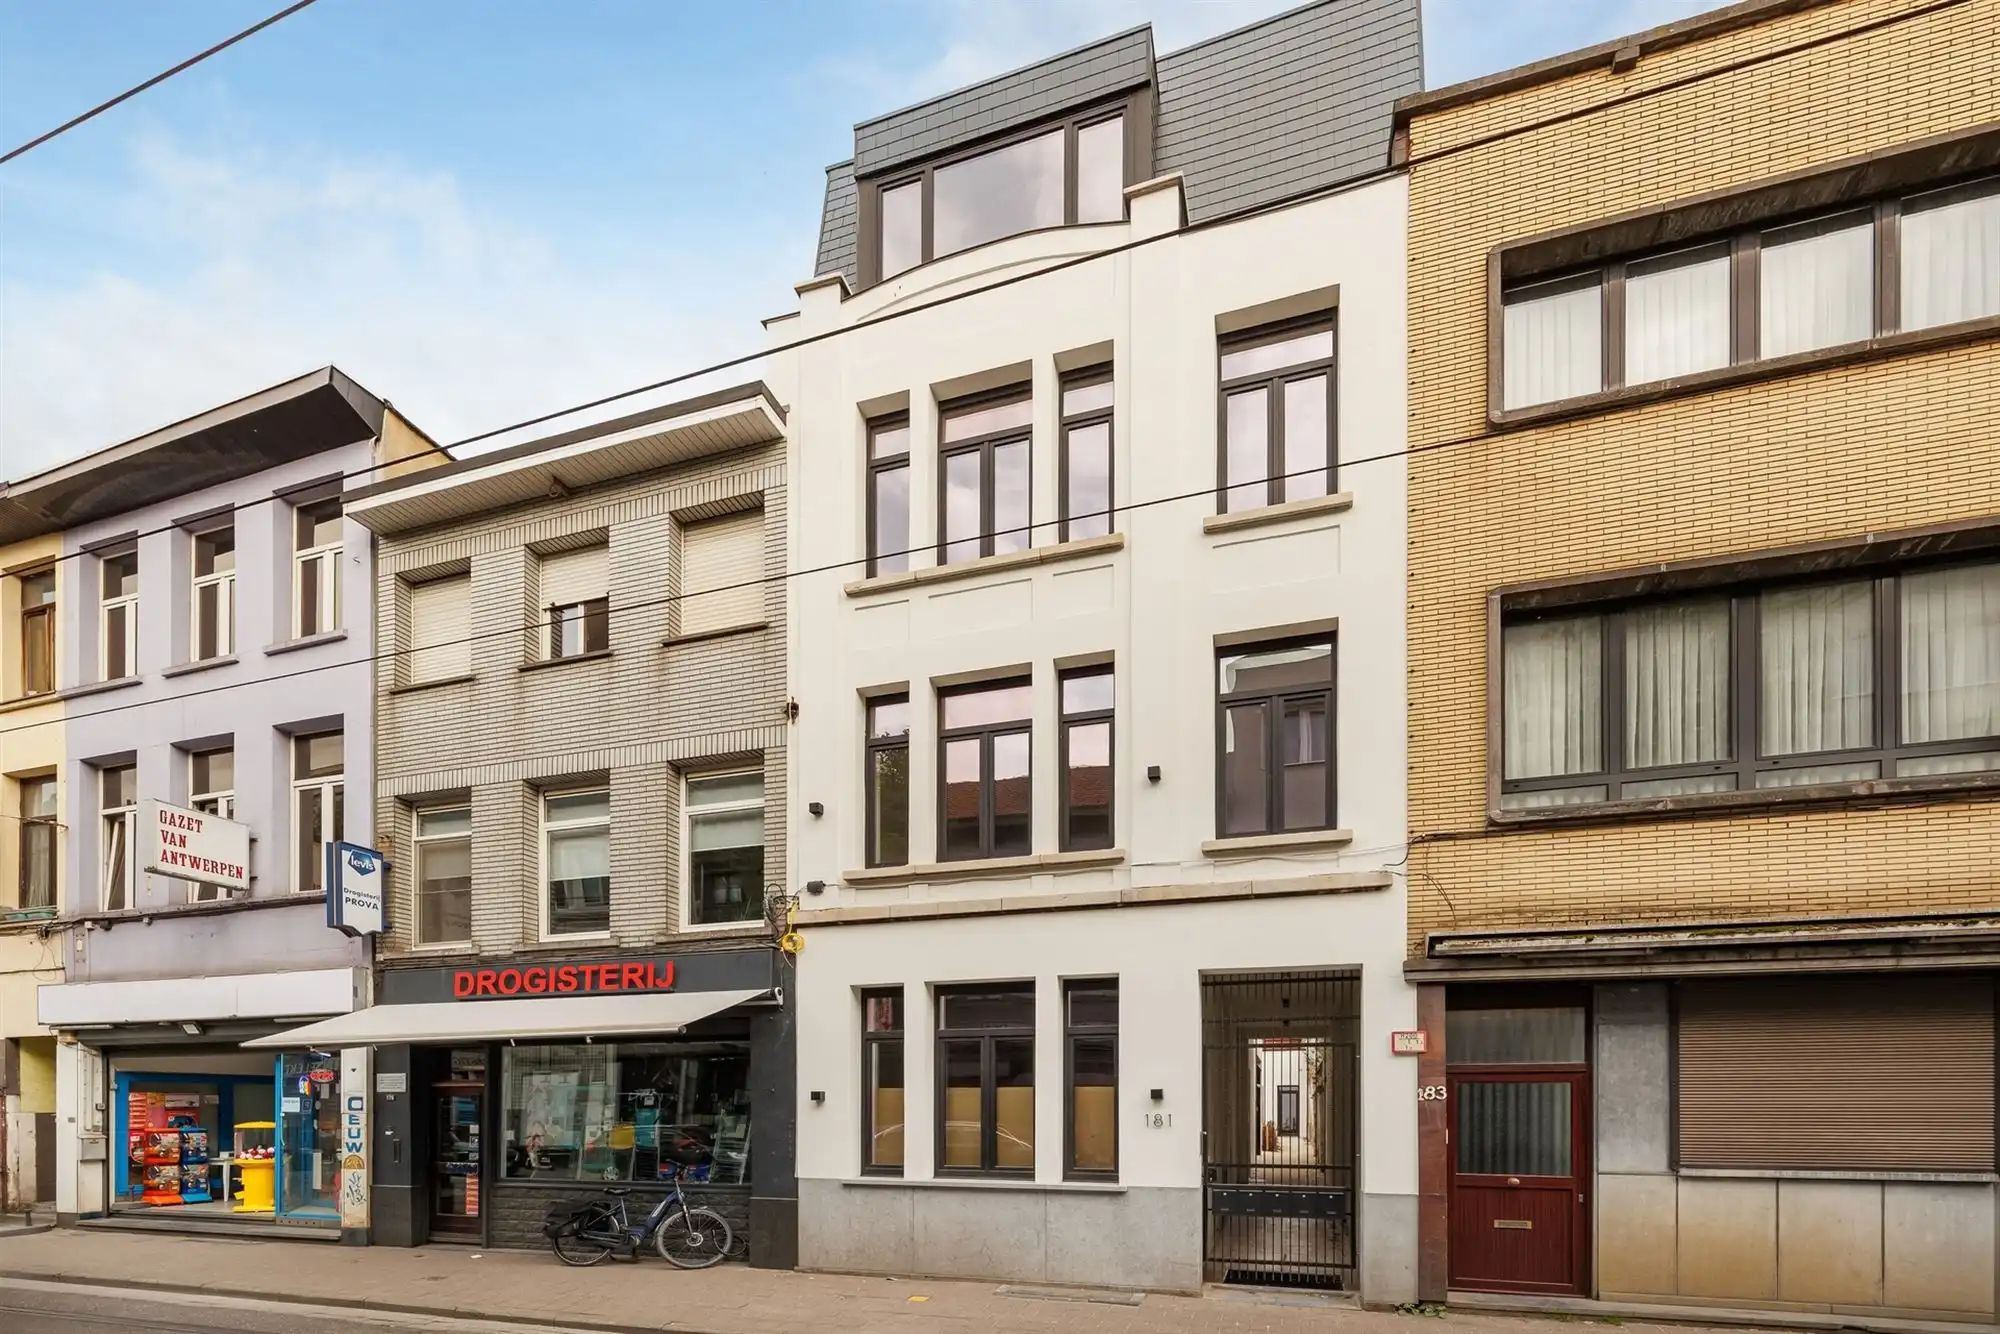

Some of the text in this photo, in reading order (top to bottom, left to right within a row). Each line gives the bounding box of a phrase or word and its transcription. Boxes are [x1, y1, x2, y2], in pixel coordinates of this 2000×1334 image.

[160, 809, 203, 833] GAZET
[160, 829, 187, 848] VAN
[160, 849, 244, 879] ANTWERPEN
[345, 897, 379, 911] PROVA
[453, 960, 675, 997] DROGISTERIJ
[1417, 1085, 1448, 1101] 183
[1144, 1113, 1172, 1128] 181
